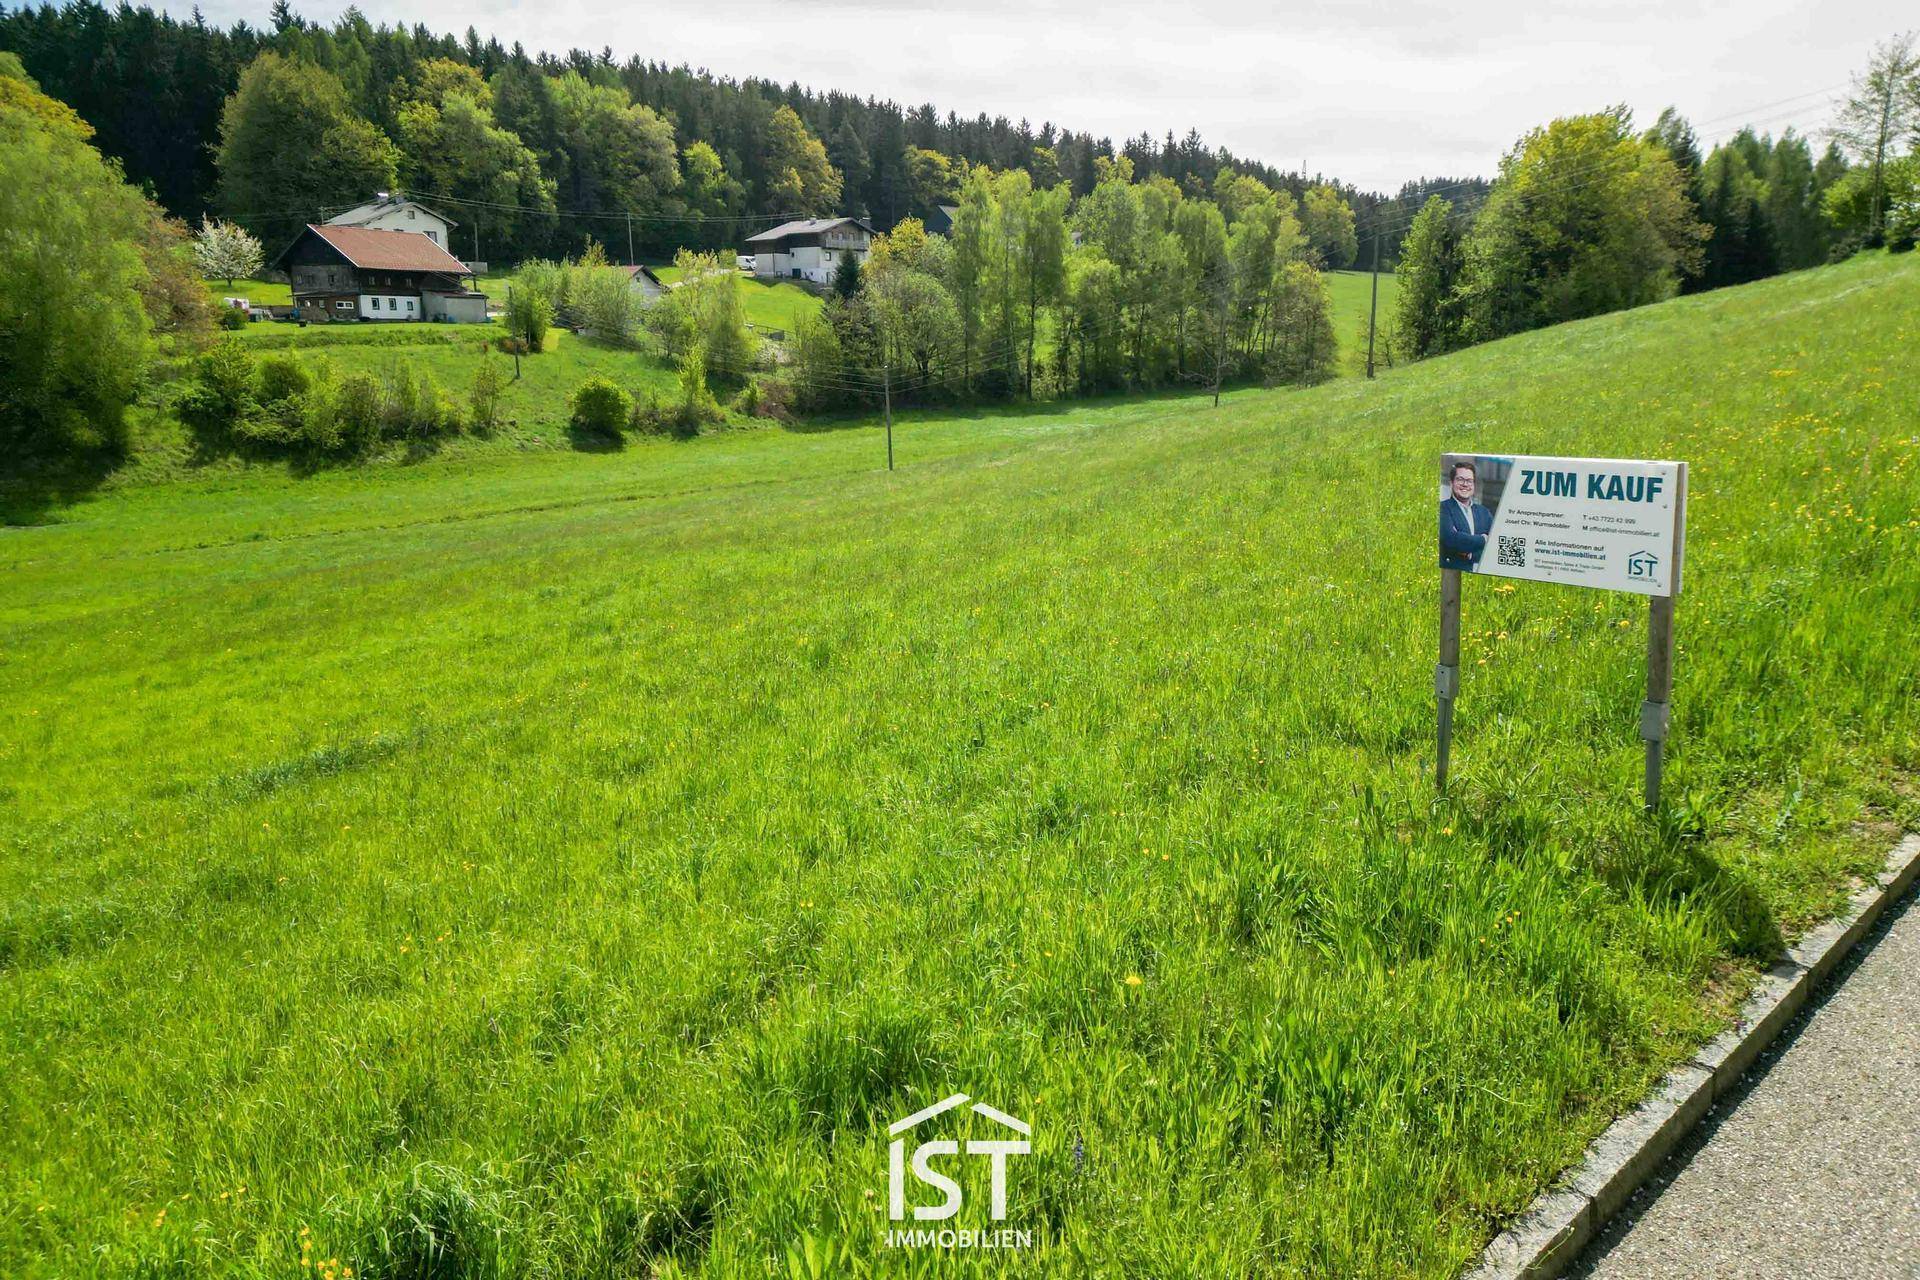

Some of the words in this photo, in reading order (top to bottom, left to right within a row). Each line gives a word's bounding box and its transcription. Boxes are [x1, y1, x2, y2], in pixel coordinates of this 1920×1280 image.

[1520, 470, 1577, 498] ZUM
[1587, 473, 1664, 503] KAUF
[1548, 540, 1592, 550] Informationen
[1534, 547, 1606, 561] www.ist-immobilien.at
[1628, 558, 1658, 577] IST
